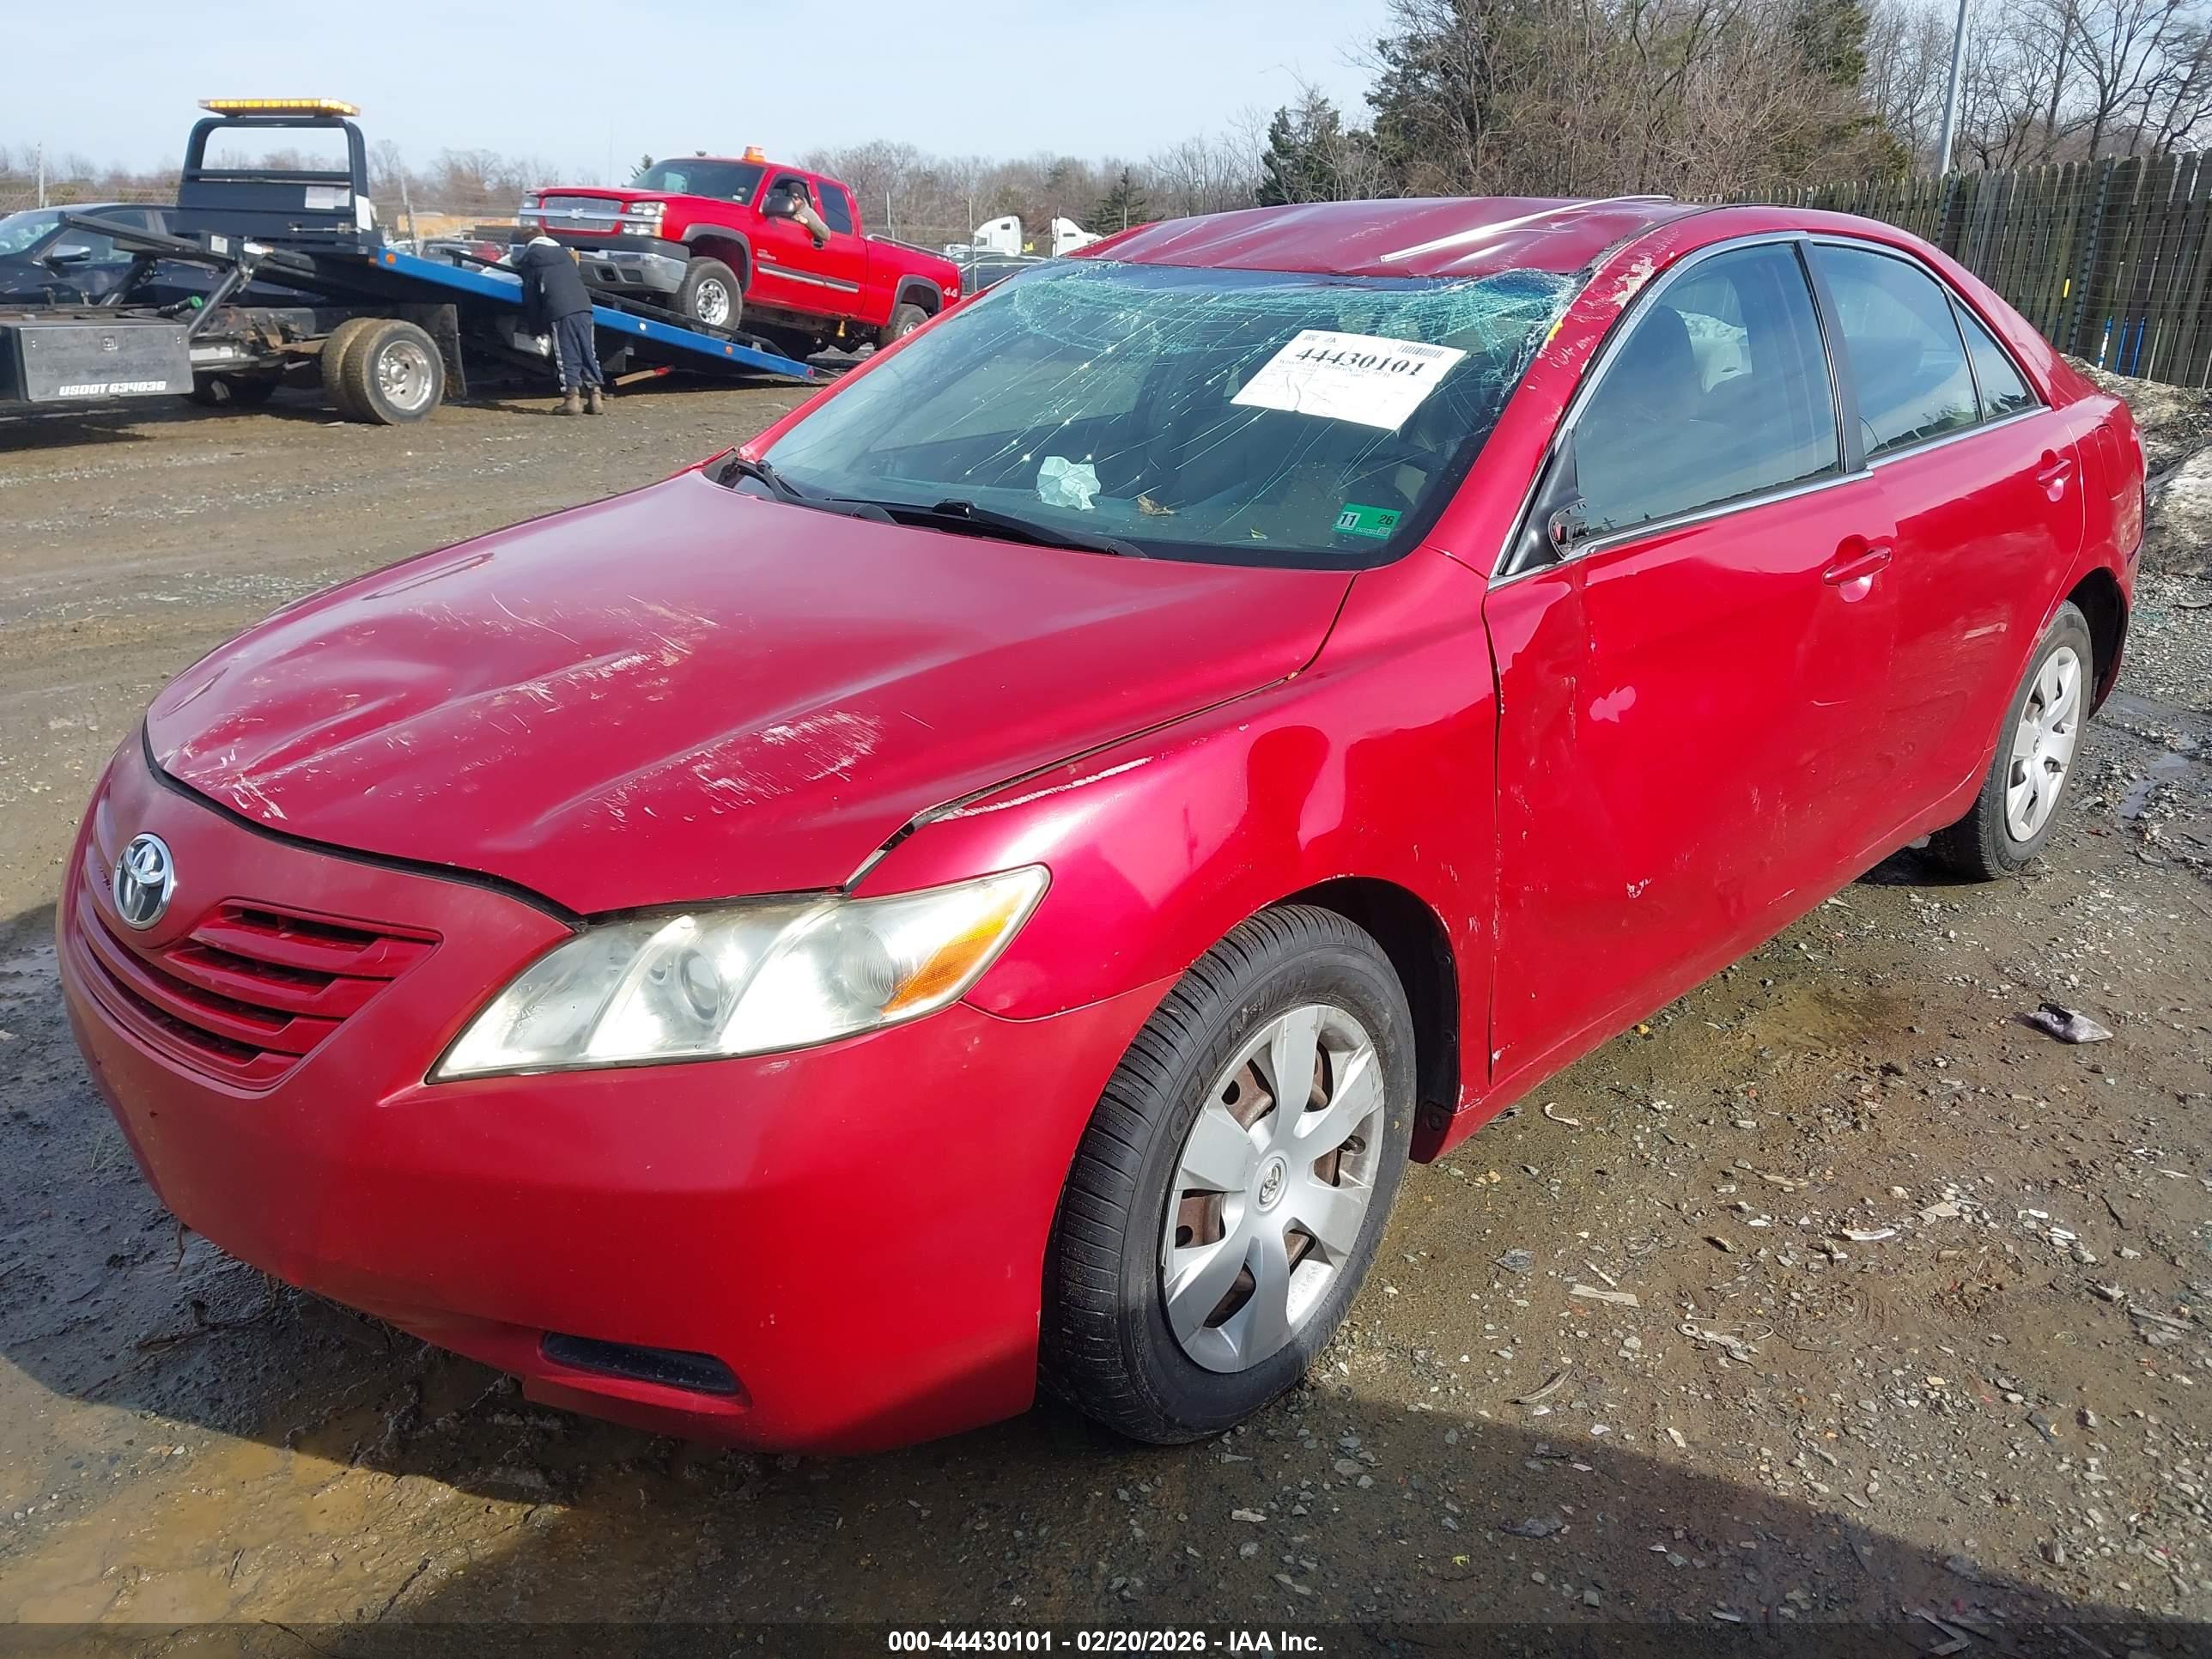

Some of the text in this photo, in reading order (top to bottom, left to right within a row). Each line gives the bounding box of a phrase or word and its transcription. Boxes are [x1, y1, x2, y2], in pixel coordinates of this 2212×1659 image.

[1296, 348, 1425, 376] 44430101
[59, 383, 108, 396] USDOT
[1340, 514, 1395, 526] 11 26
